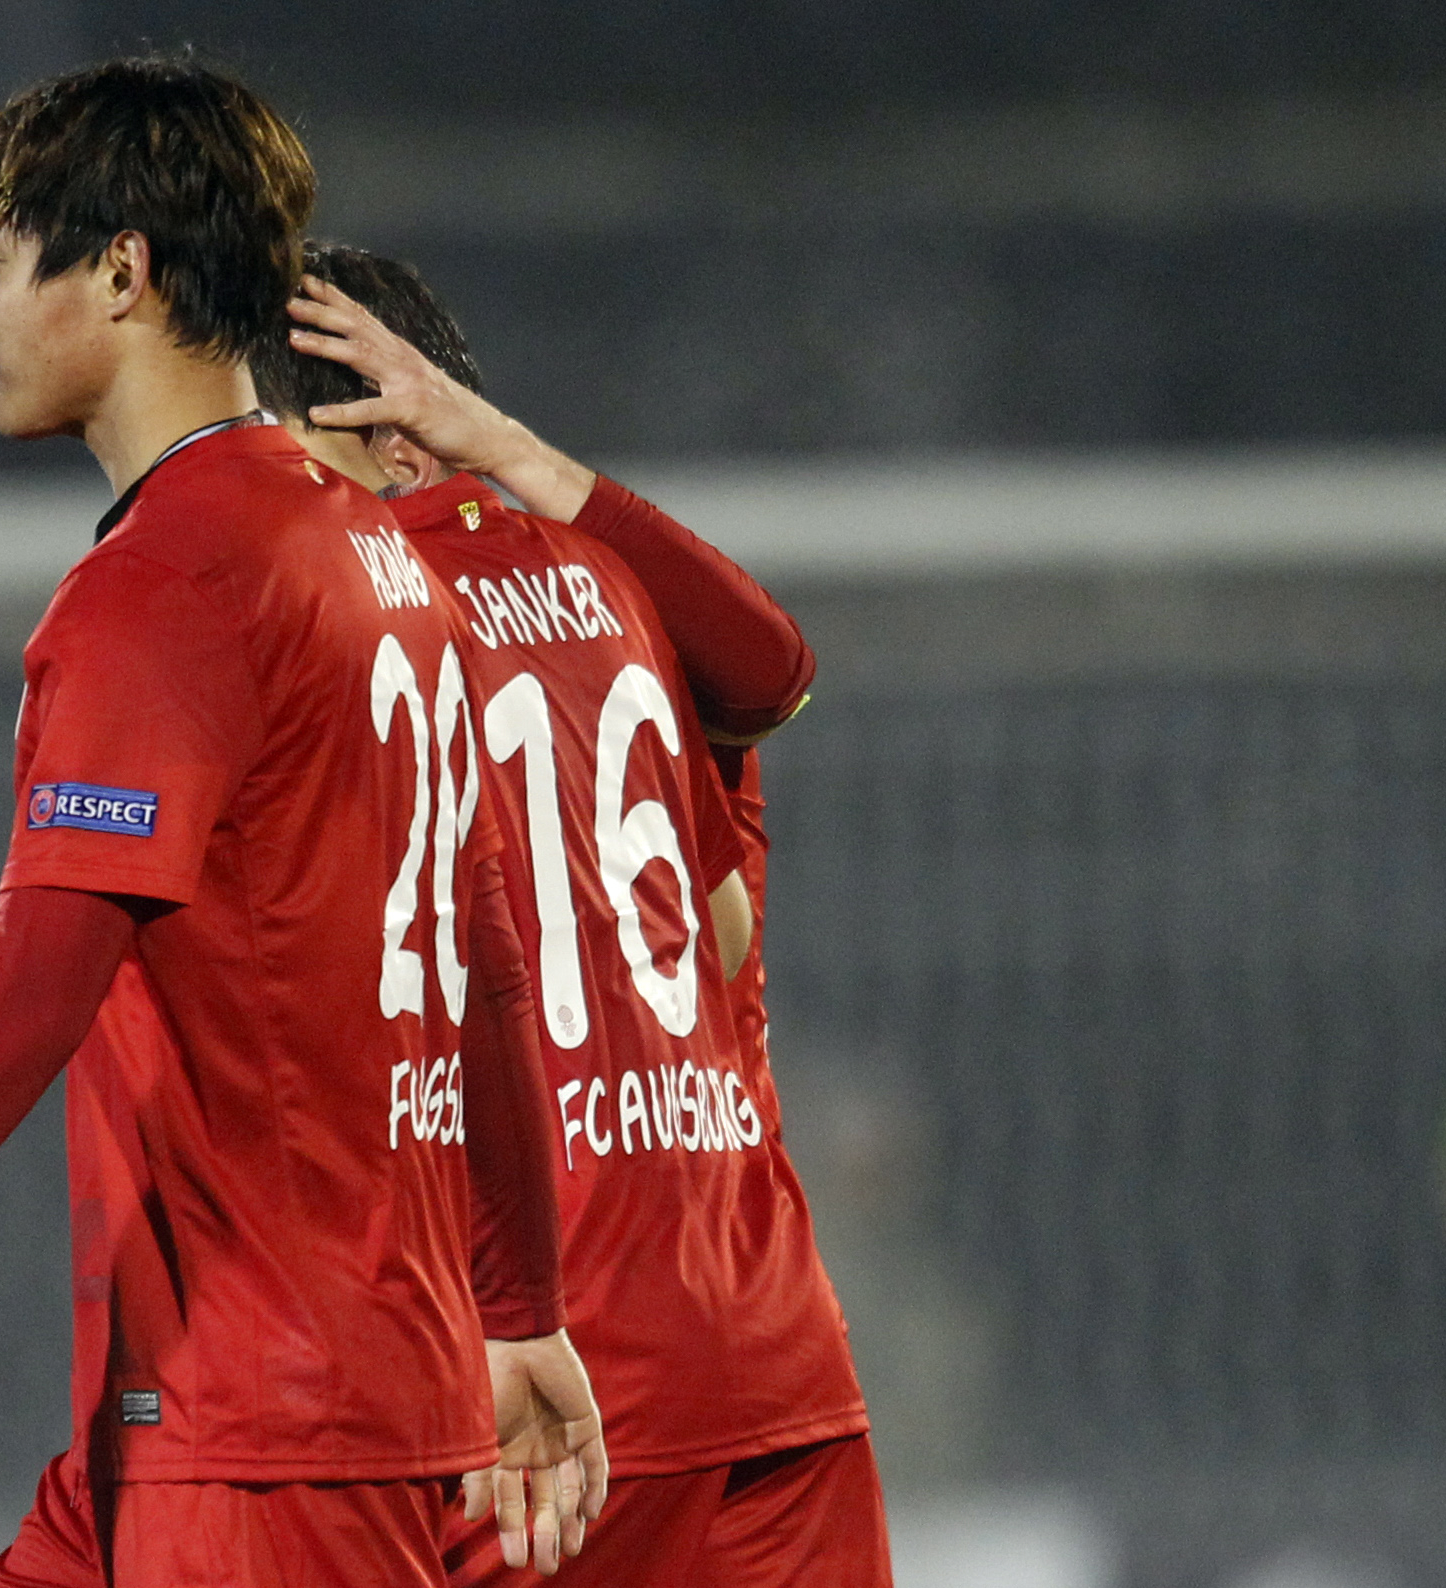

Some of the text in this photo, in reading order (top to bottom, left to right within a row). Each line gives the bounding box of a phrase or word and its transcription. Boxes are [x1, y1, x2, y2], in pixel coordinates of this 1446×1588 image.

[454, 563, 624, 651] JANKER
[55, 794, 157, 825] RESPECT
[483, 663, 700, 1050] 16
[556, 1077, 613, 1172] FC
